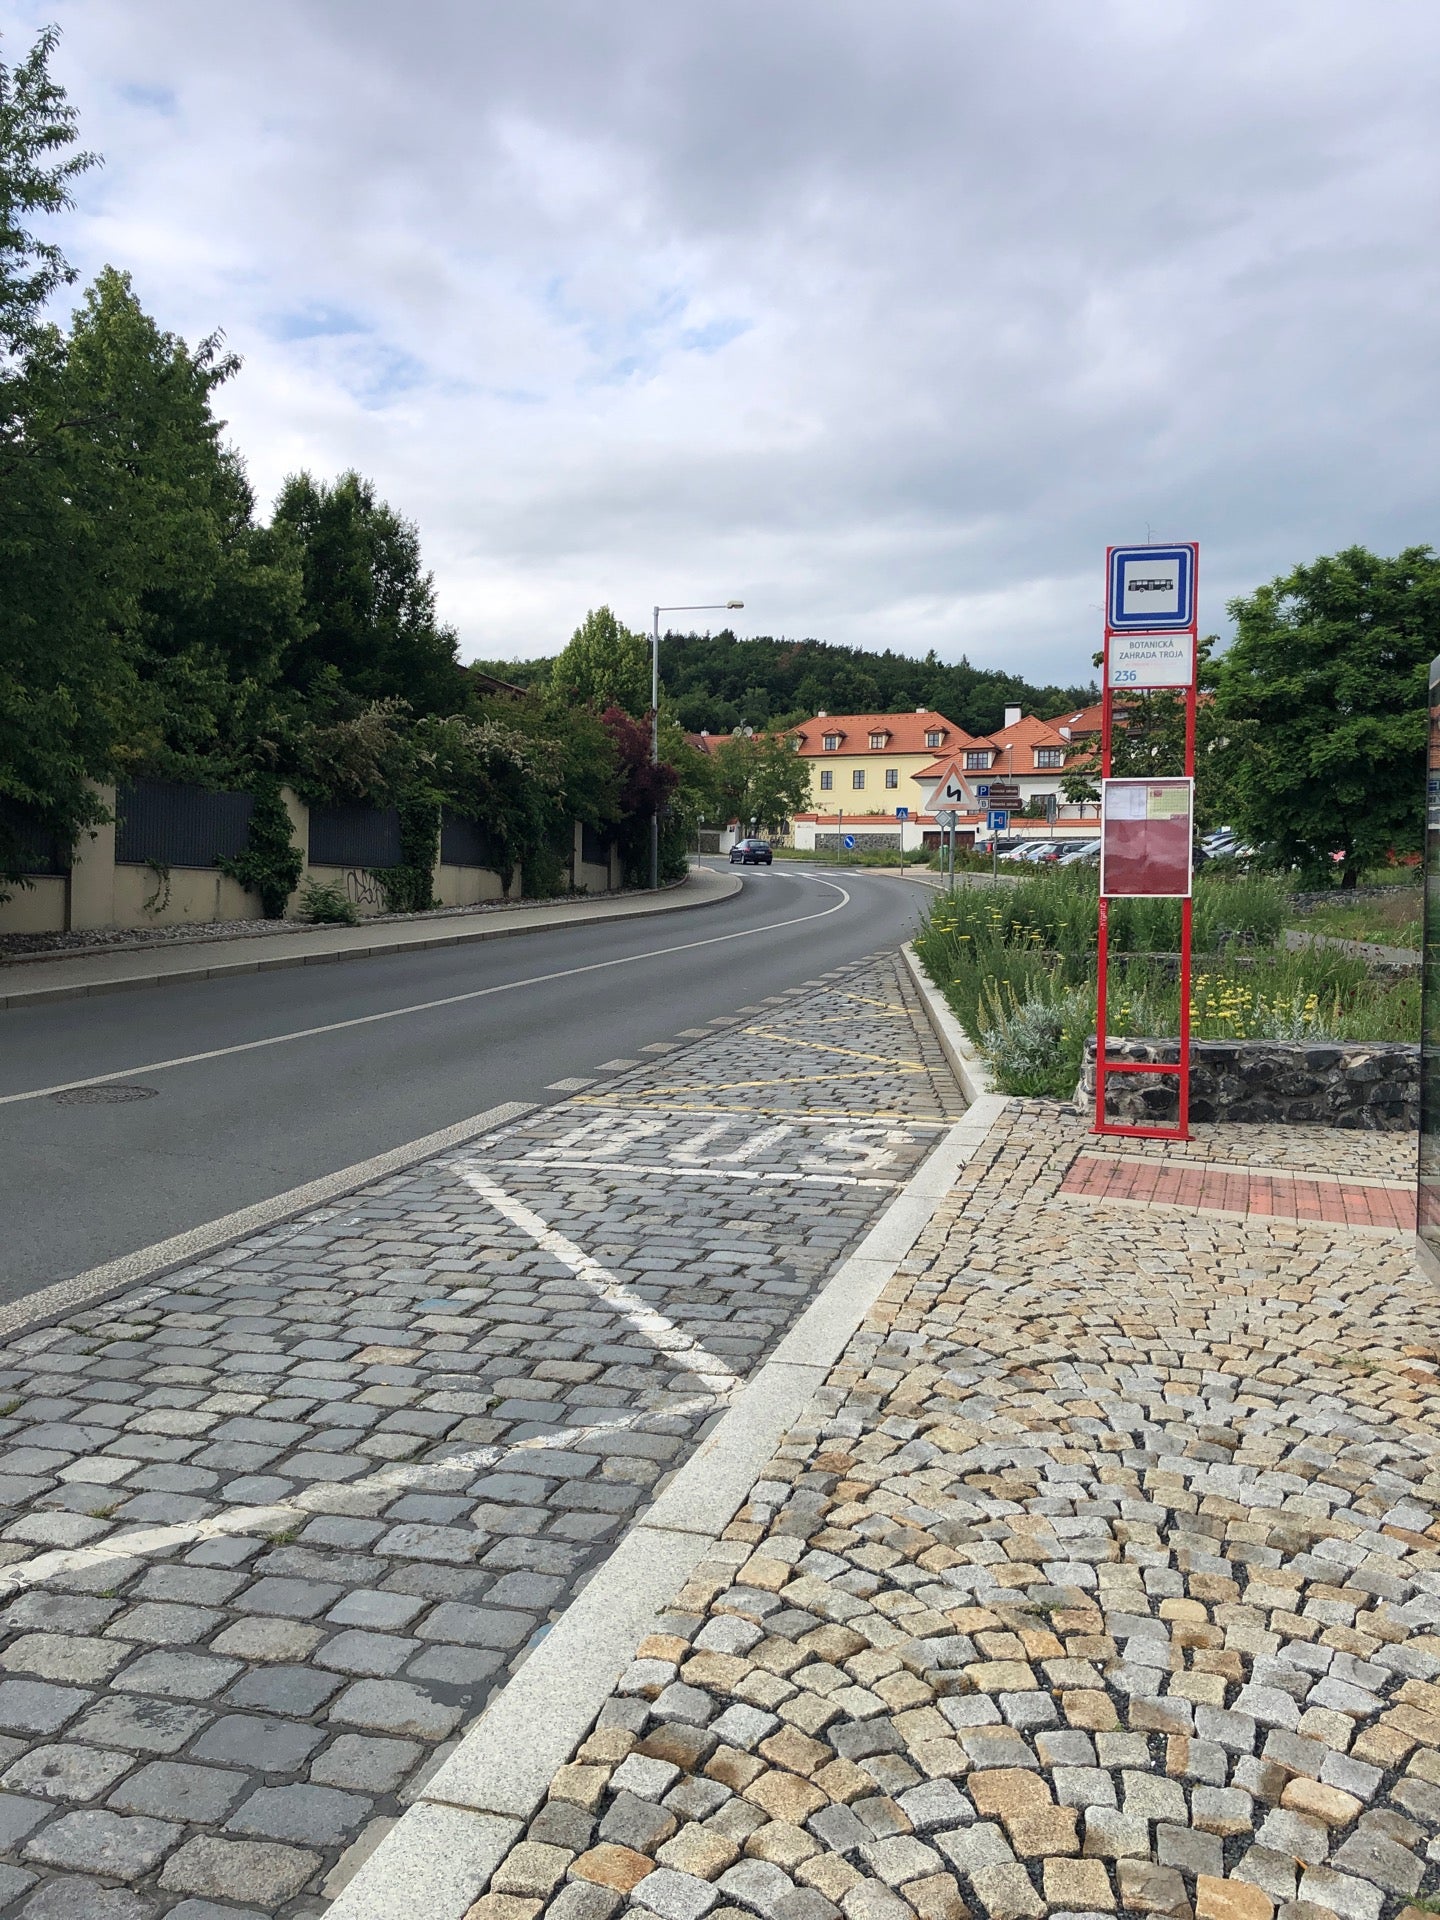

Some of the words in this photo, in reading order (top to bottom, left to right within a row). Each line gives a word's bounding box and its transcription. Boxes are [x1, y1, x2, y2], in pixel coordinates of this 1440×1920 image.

[1130, 640, 1174, 649] BOTANICKÁ
[1114, 670, 1137, 682] 236
[980, 787, 986, 795] P
[524, 1116, 916, 1172] BUS
